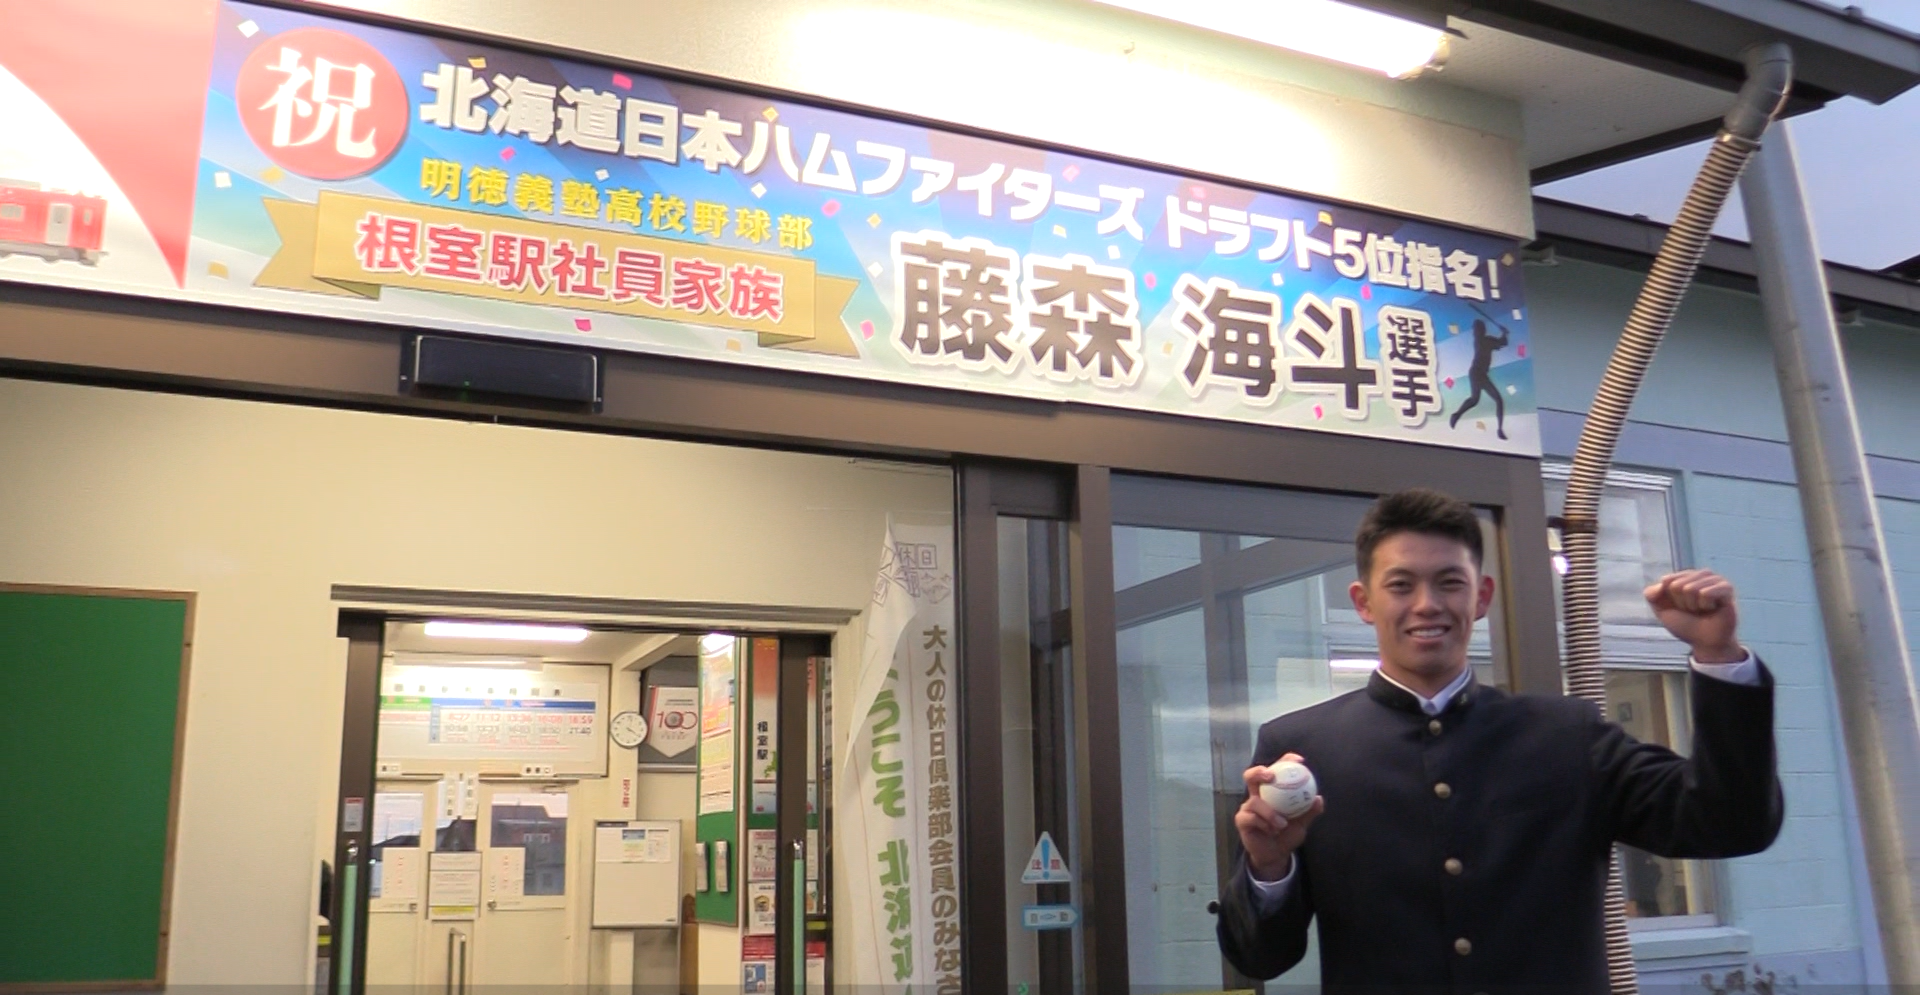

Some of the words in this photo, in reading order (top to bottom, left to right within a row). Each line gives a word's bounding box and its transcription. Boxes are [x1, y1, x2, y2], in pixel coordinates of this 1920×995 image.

[260, 47, 376, 158] 祝
[420, 62, 1144, 241] 北海道日本ハムファイターズ
[356, 213, 784, 321] 根室駅社員家族
[420, 158, 814, 250] 明徳義塾高校野球部
[896, 236, 1136, 381] 藤森
[1176, 281, 1378, 411] 海斗
[1386, 312, 1435, 420] 選手
[867, 652, 906, 818] うこそ
